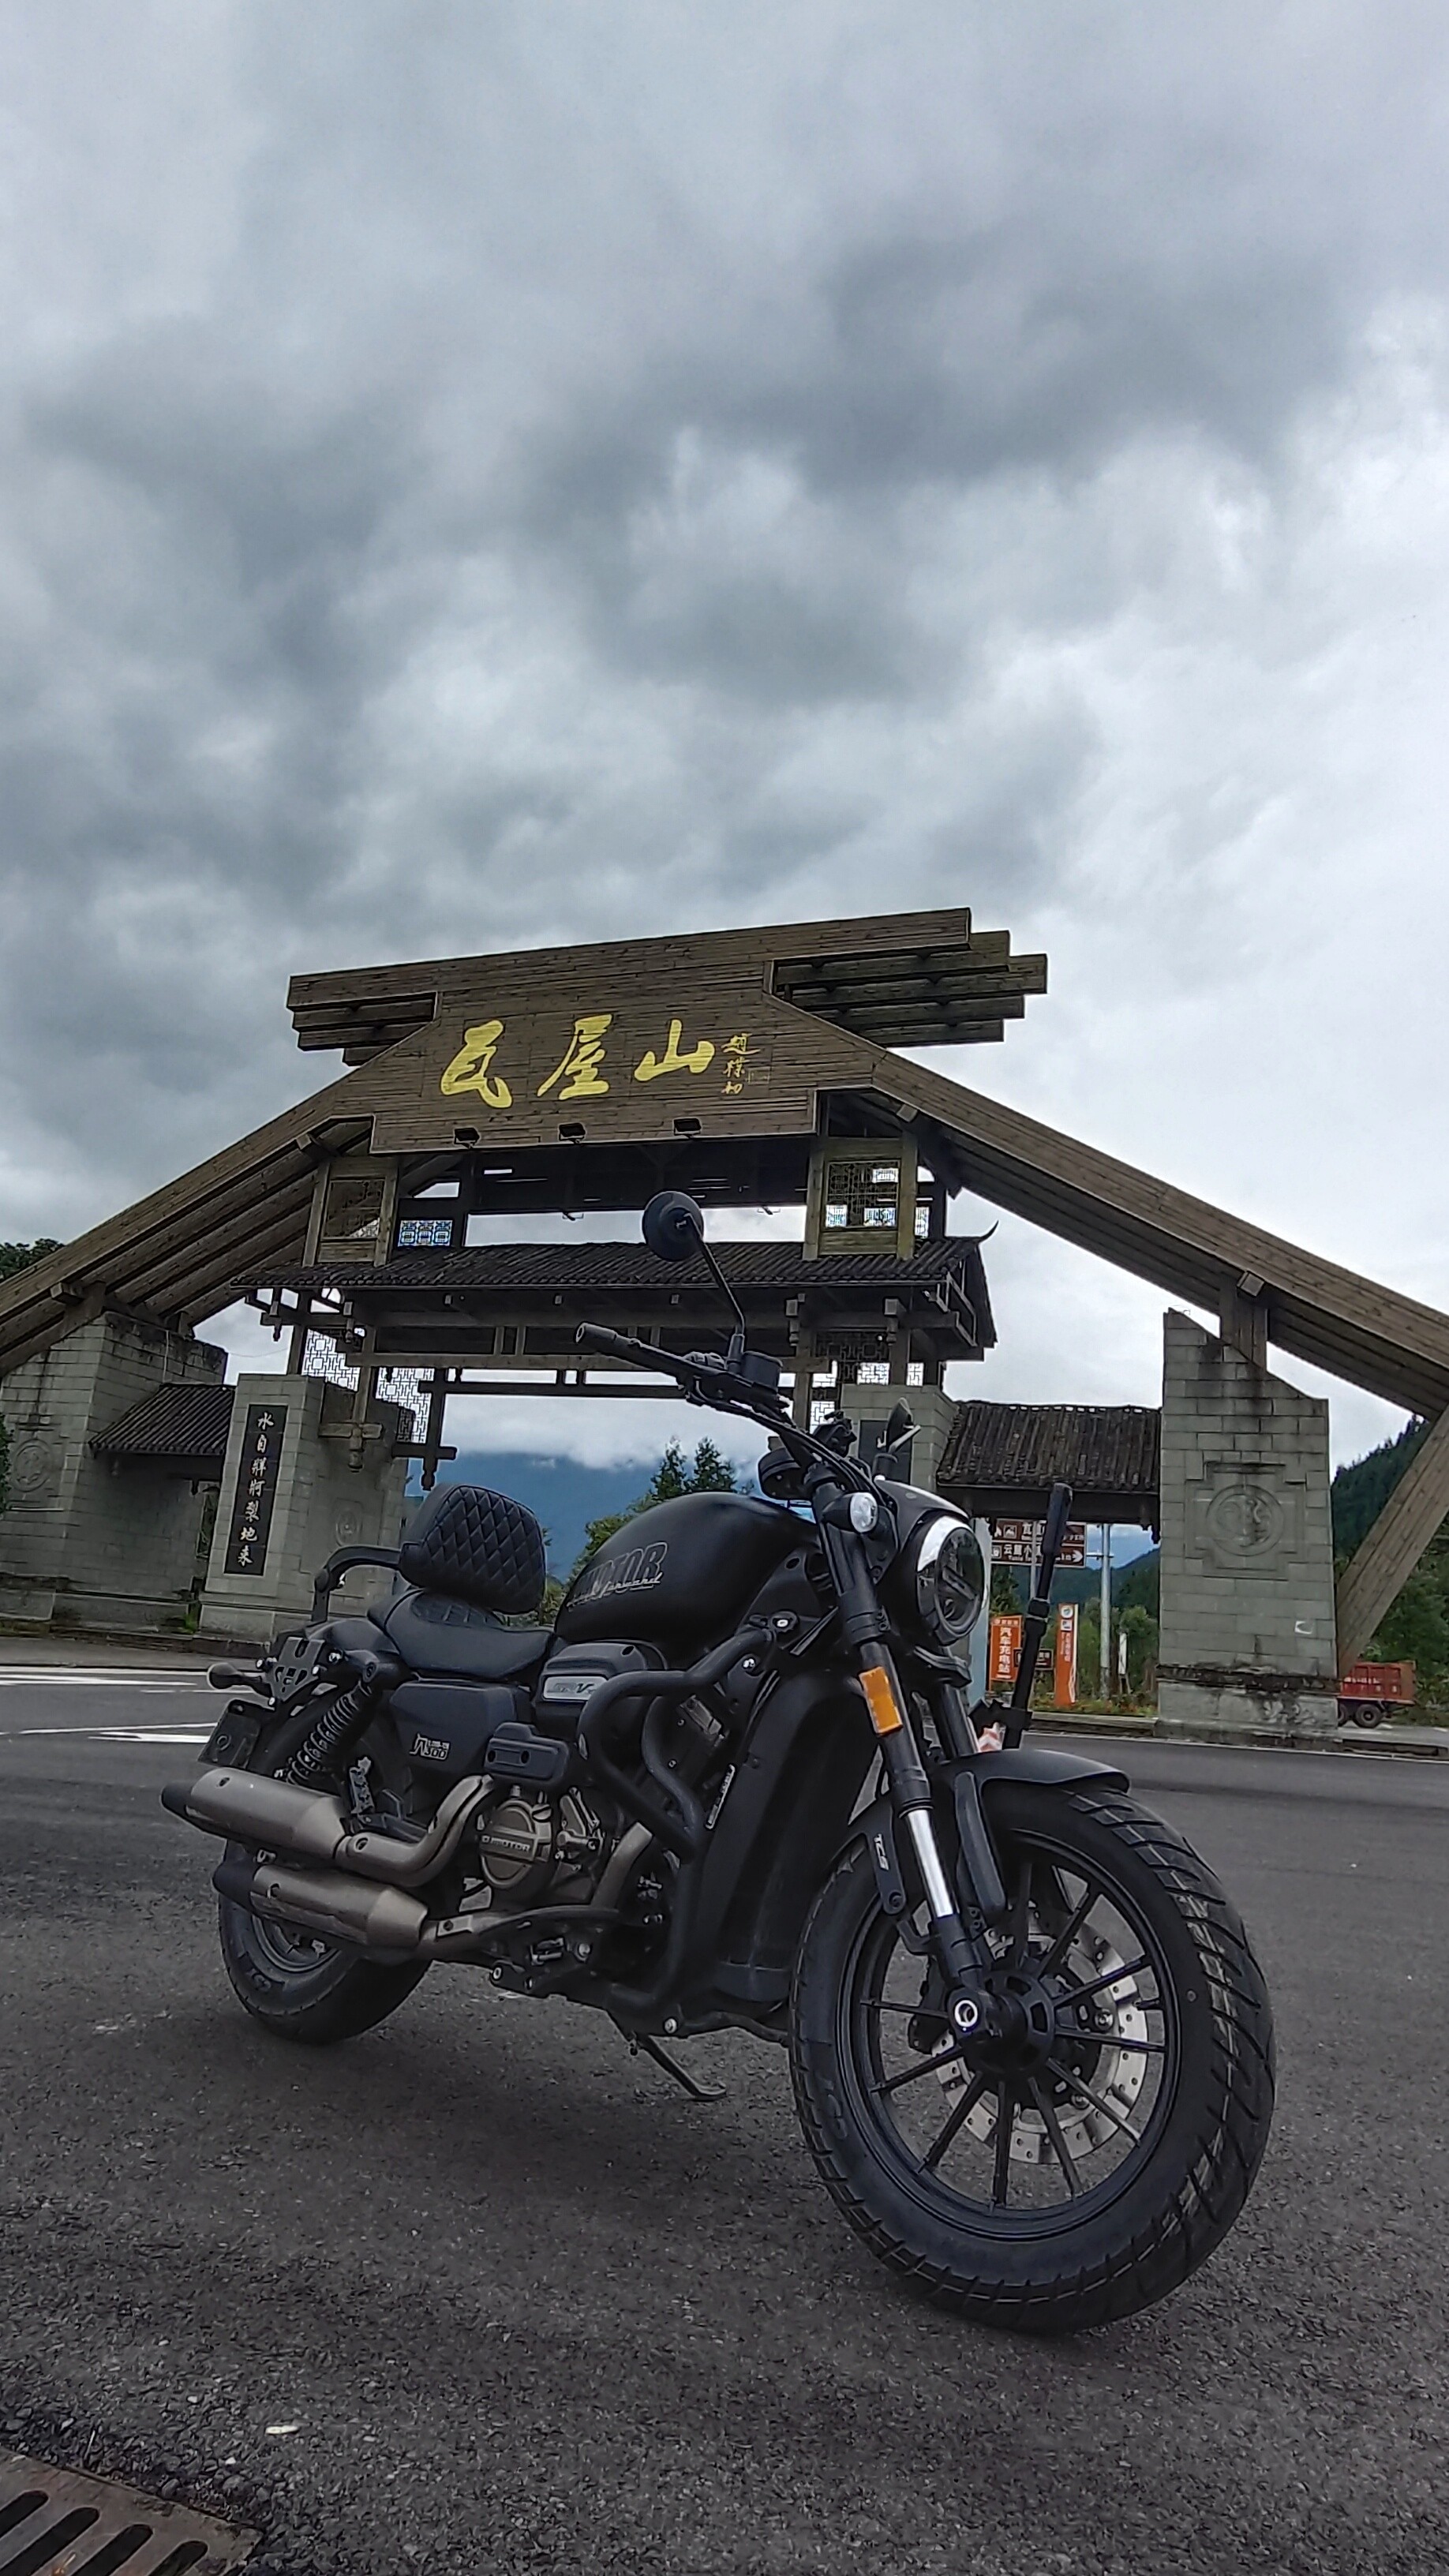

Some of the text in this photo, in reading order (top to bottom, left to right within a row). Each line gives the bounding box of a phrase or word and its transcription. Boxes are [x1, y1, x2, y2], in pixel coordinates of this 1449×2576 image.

[440, 1014, 715, 1108] 瓦屋山
[998, 1627, 1012, 1674] 汽车充电站
